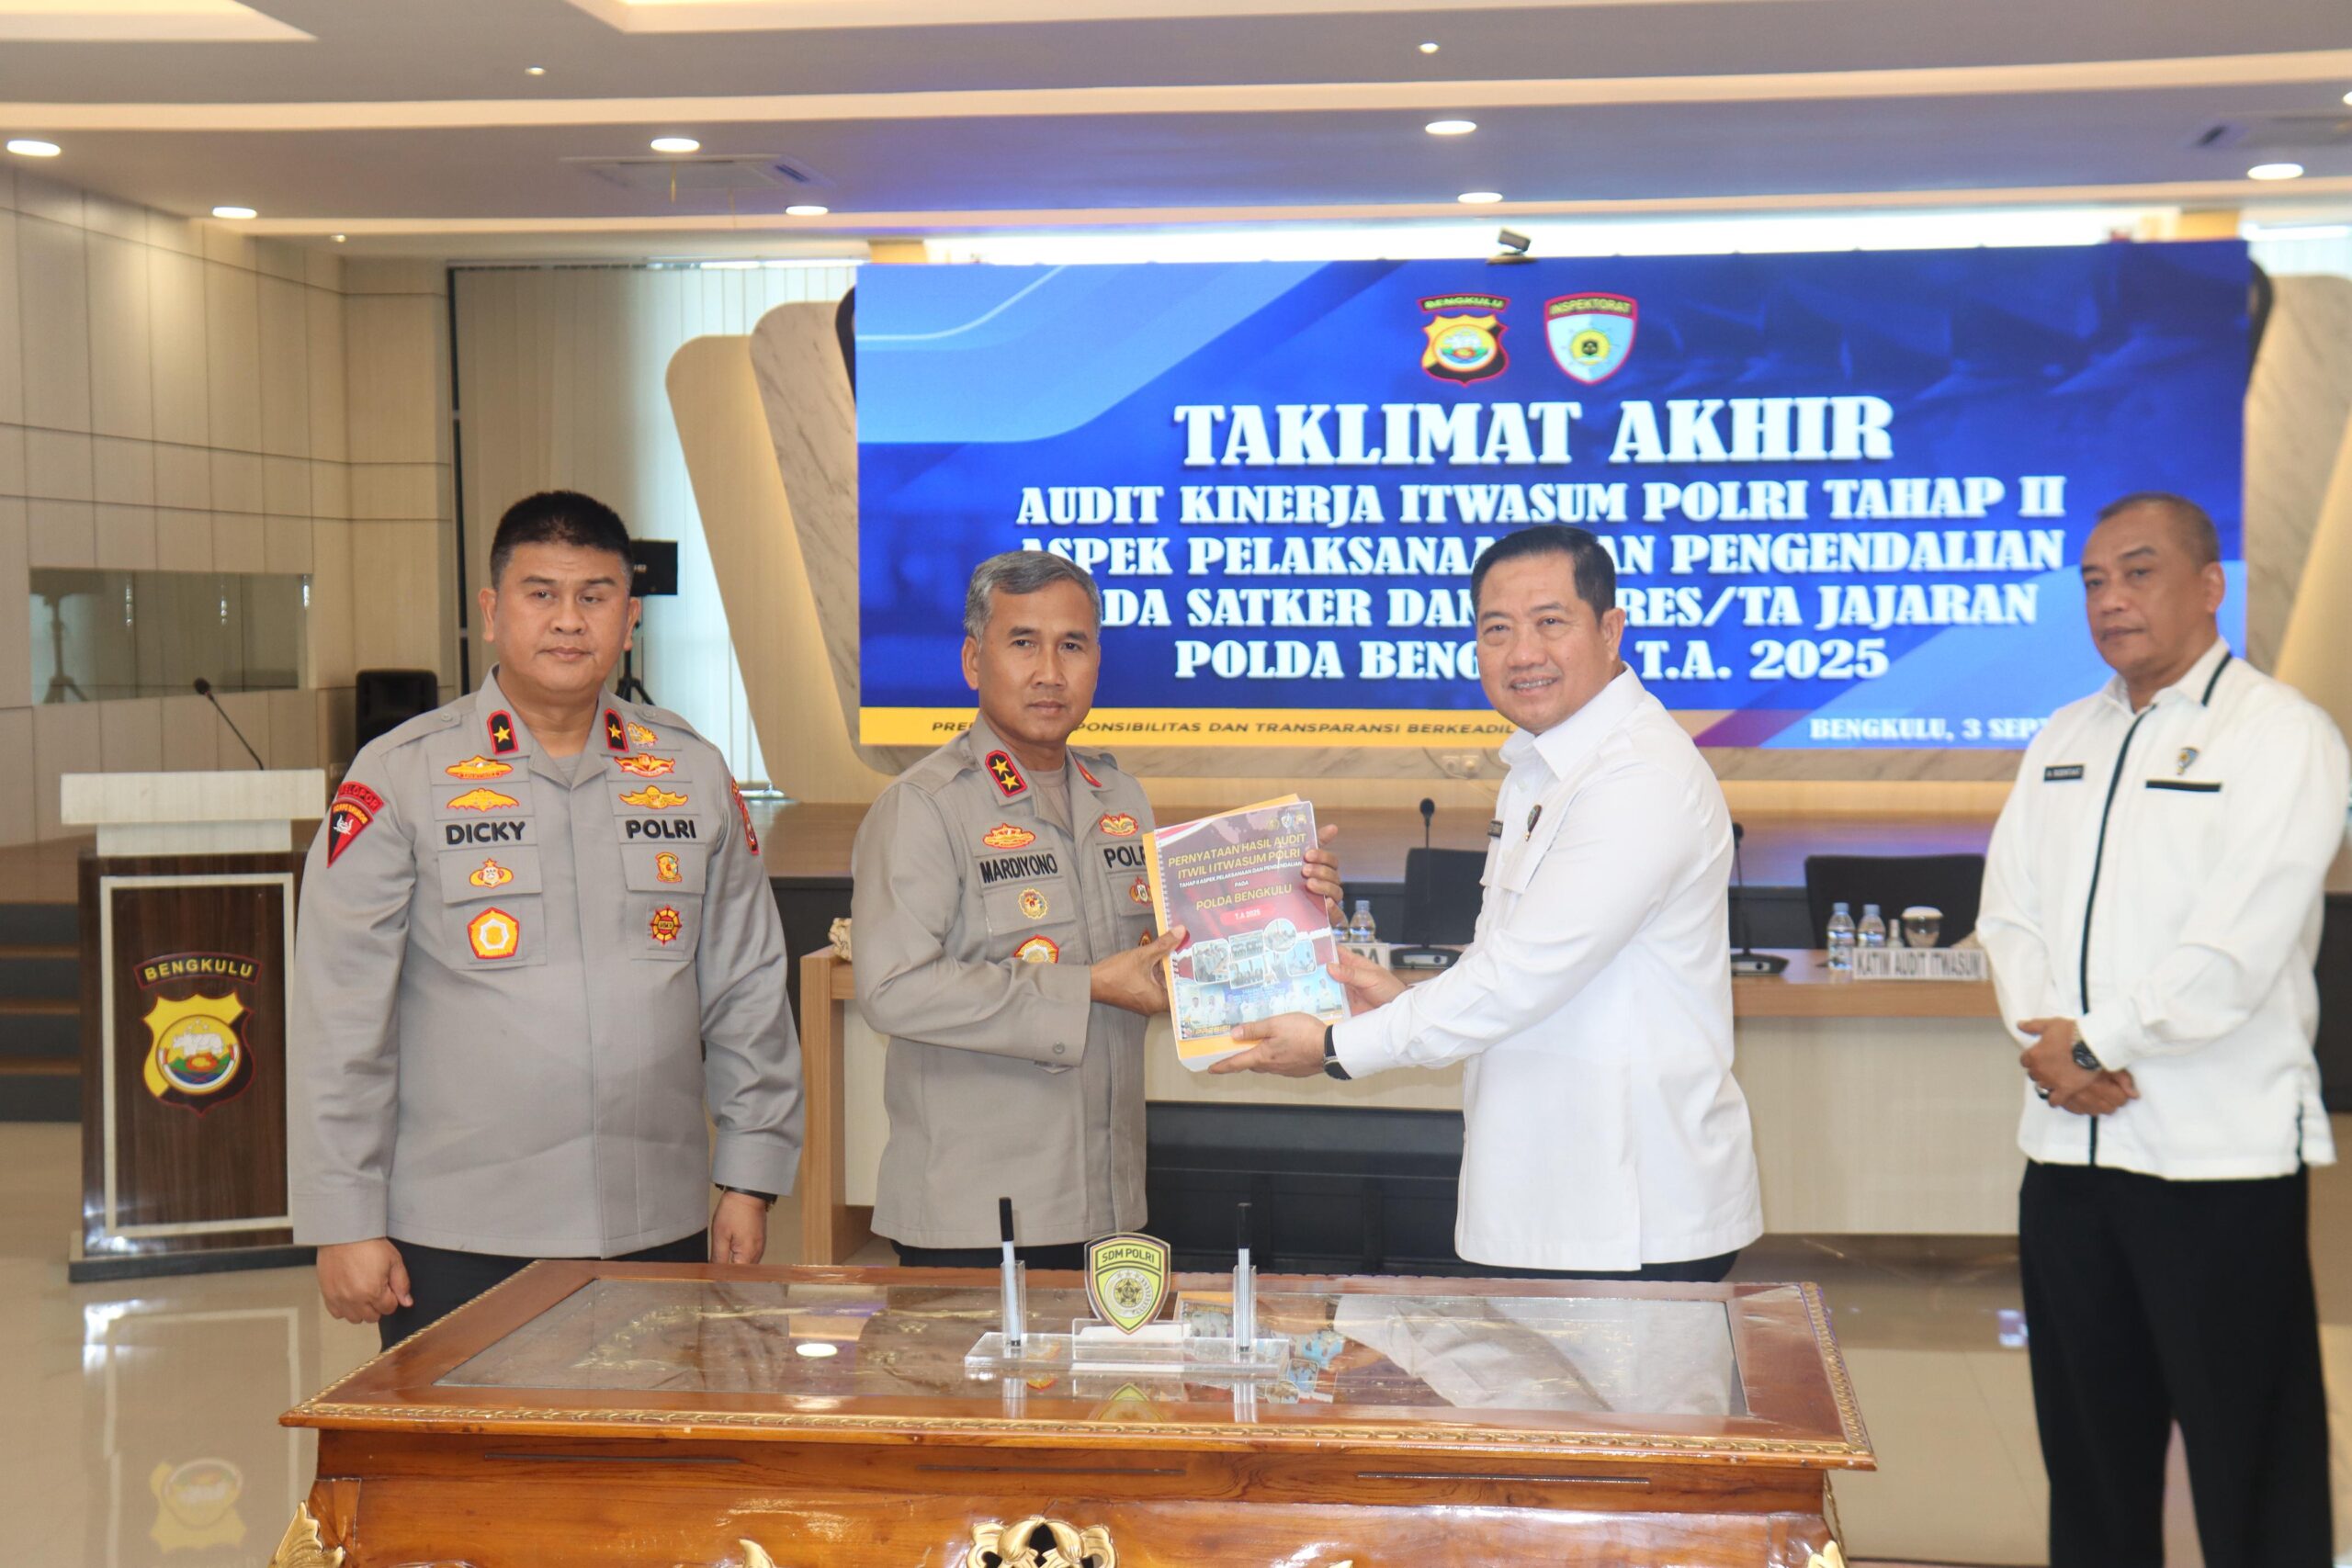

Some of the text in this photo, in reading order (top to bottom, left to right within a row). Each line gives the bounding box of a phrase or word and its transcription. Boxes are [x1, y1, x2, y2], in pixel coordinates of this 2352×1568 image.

[1423, 295, 1505, 310] BENGKULU
[1548, 298, 1633, 316] INSPEKTORAT
[1173, 395, 1894, 466] TAKLIMAT AKHIR
[1015, 475, 2067, 528] AUDIT KINERJA ITWASUM POLRI TAHAP II
[1598, 535, 1656, 575] AN
[1669, 529, 2066, 575] PENGENDALIAN
[1101, 588, 1172, 626] DA
[1186, 588, 1373, 626] SATKER
[1615, 585, 1804, 627] RES/TA
[1814, 583, 2039, 630] JAJARAN
[1174, 637, 1890, 681] POLDA BENG T.A. 2025
[1074, 721, 1202, 733] PONSIBILITAS
[1208, 722, 1249, 733] DAN
[1255, 722, 1401, 734] TRANSPARANSI
[1407, 723, 1516, 735] BERKEADIL
[1809, 717, 1955, 742] BENGKULU,
[1962, 717, 1982, 740] 3
[341, 784, 379, 809] ELOPOR
[445, 820, 526, 845] DICKY
[625, 819, 696, 840] POLRI
[1103, 846, 1146, 868] POL
[1168, 833, 1307, 868] PERNYATAAN HASIL AUDIT
[979, 852, 1058, 884] MARDIYONO
[1177, 865, 1207, 880] ITWIL
[1213, 853, 1267, 873] ITWASUM
[1268, 848, 1301, 863] POLRI
[1234, 880, 1250, 888] PADA
[1195, 884, 1293, 911] POLDA BENGKULU
[143, 958, 254, 981] BENGKULU
[1102, 1248, 1155, 1263] SDM POLRI
